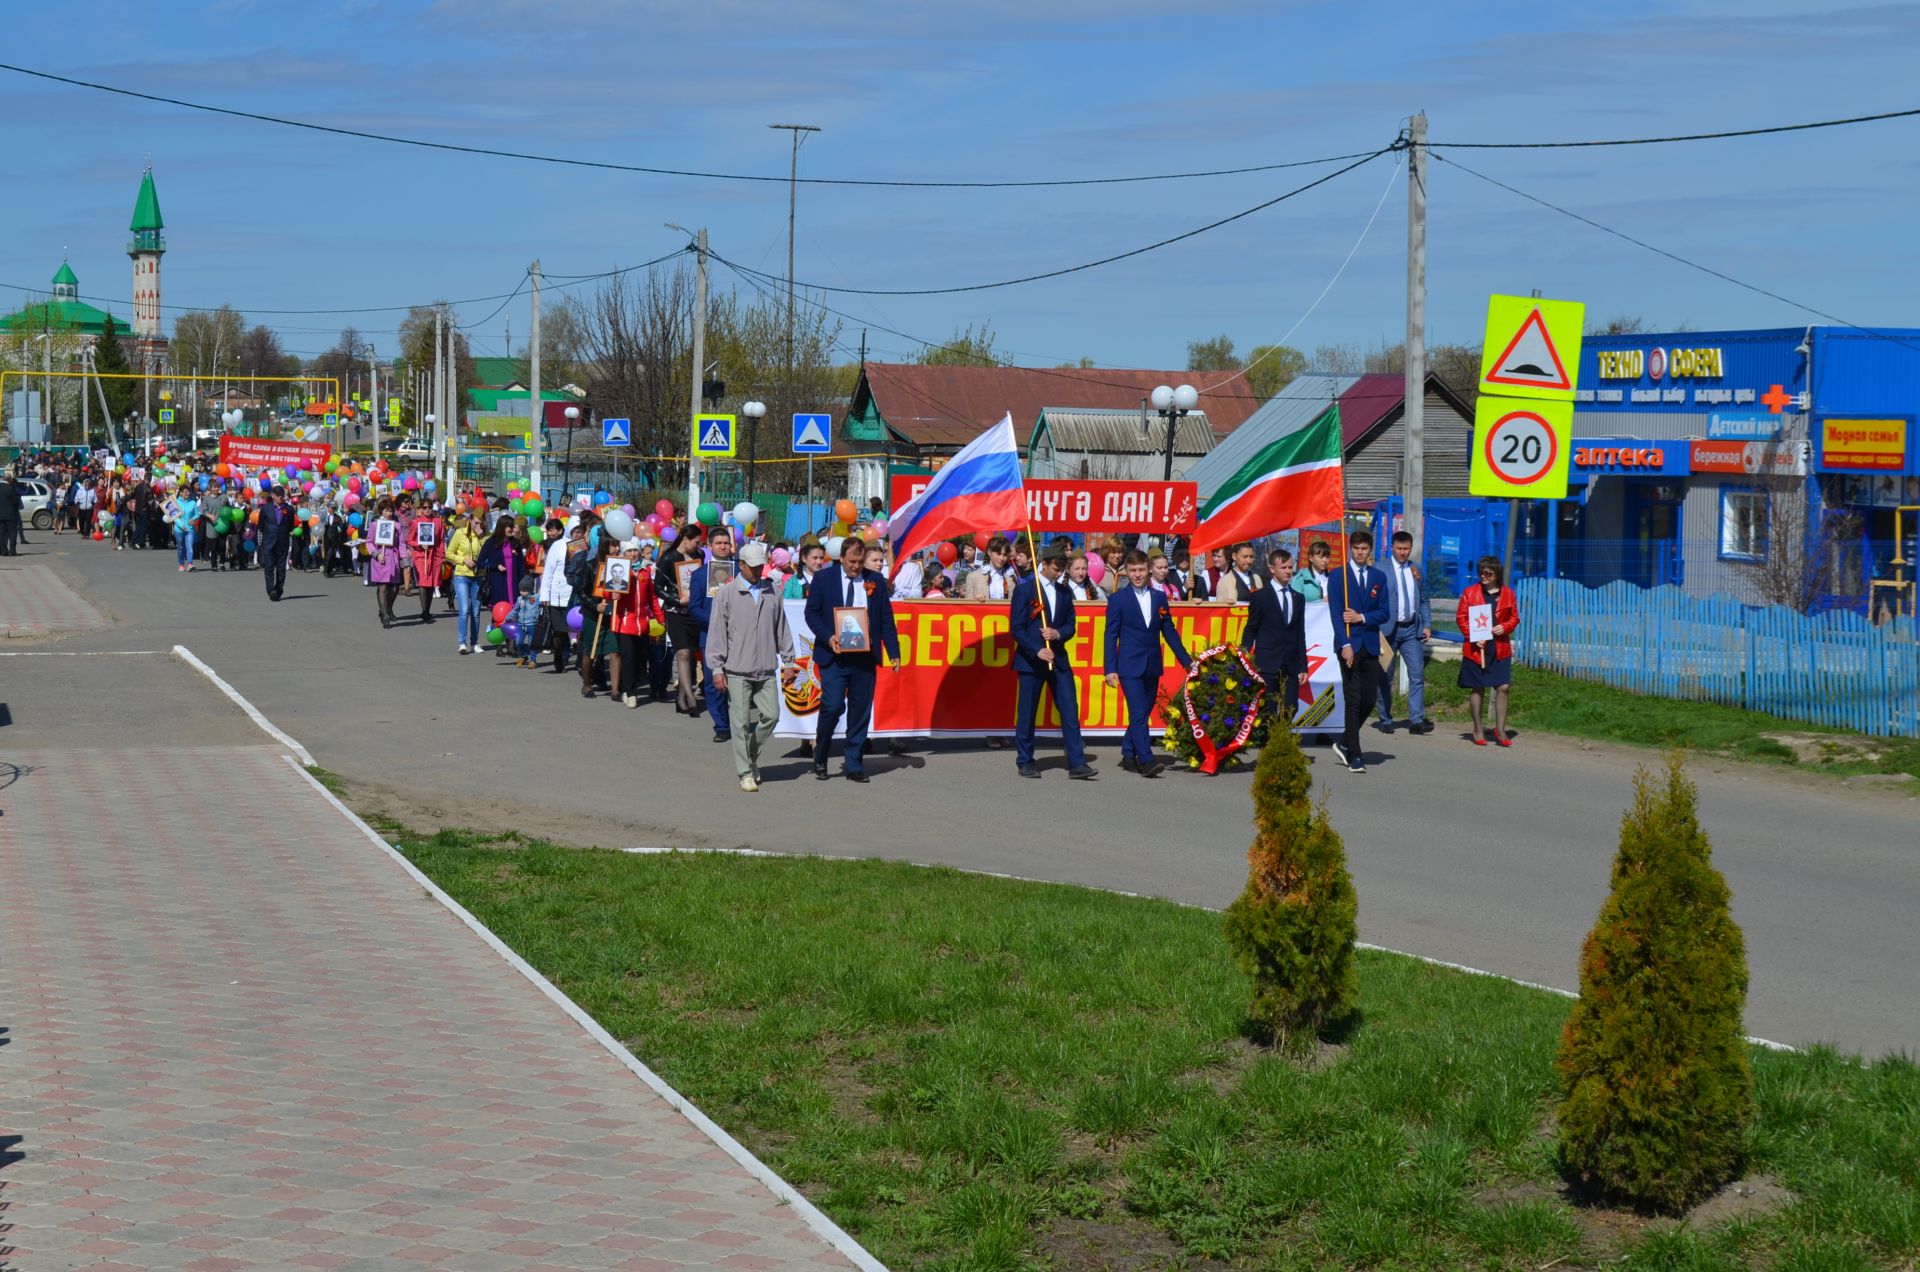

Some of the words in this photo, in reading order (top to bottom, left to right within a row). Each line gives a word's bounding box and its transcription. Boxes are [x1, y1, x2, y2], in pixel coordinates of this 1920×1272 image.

[1597, 350, 1644, 378] ТЕХНО
[1670, 347, 1723, 378] СФЕРА
[1500, 433, 1541, 465] 20
[1573, 446, 1664, 467] аптека
[1694, 447, 1741, 466] бережная
